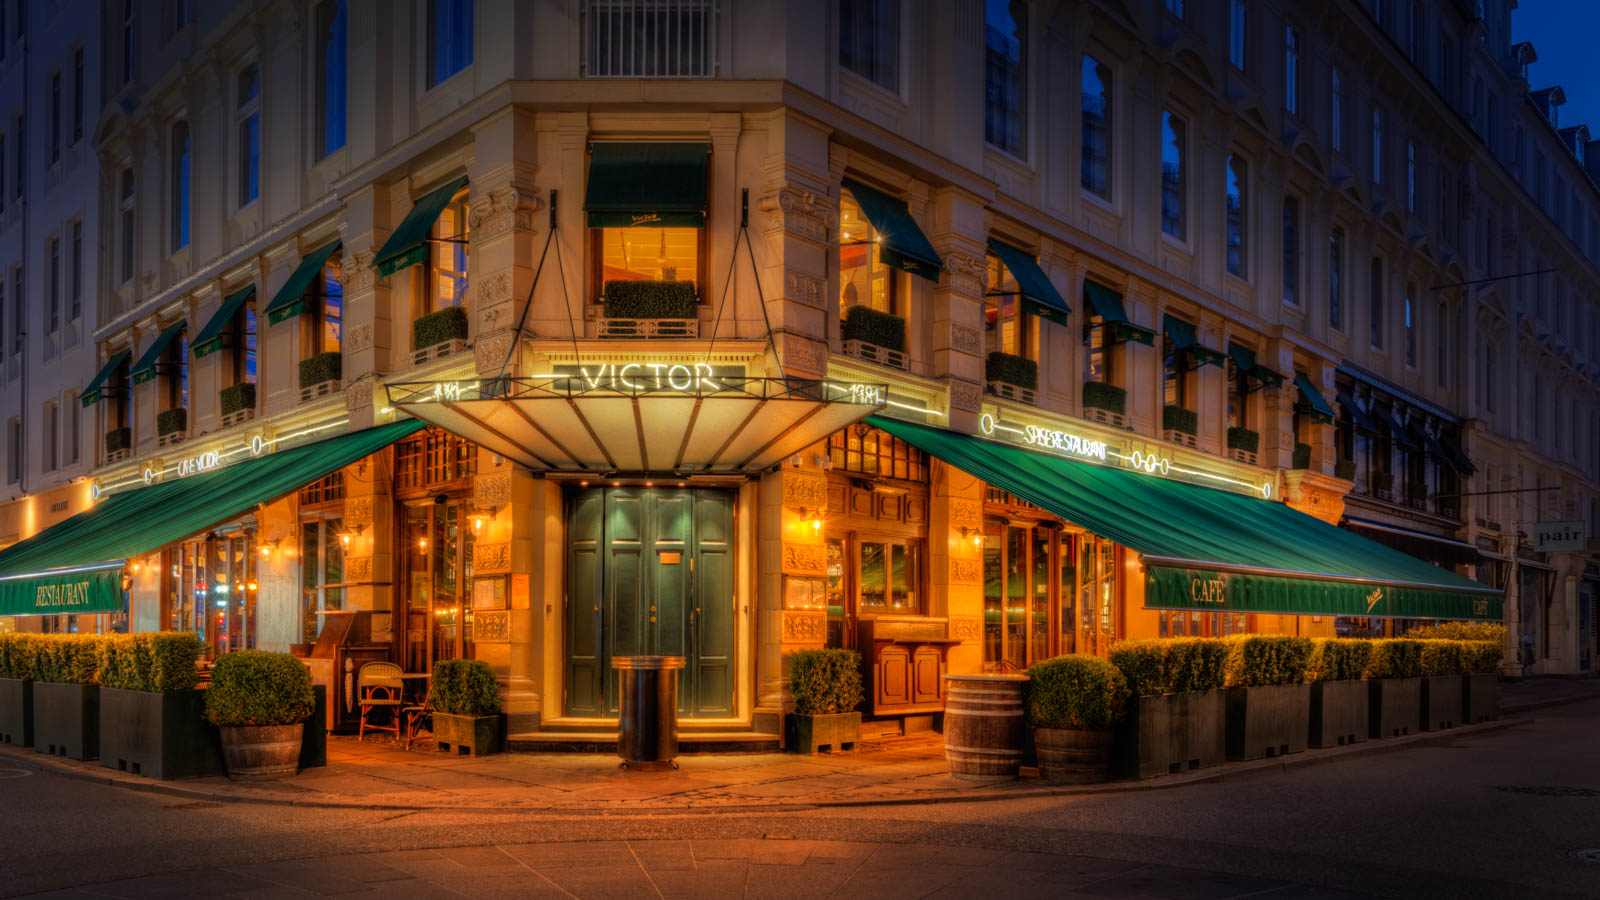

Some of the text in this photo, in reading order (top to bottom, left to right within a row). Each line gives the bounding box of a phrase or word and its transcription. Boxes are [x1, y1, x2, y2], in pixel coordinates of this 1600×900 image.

[581, 363, 719, 391] VICTOR
[849, 384, 879, 405] 1981
[1538, 526, 1581, 547] pair
[35, 581, 90, 607] RESTAURANT
[1191, 576, 1225, 602] CAFÉ
